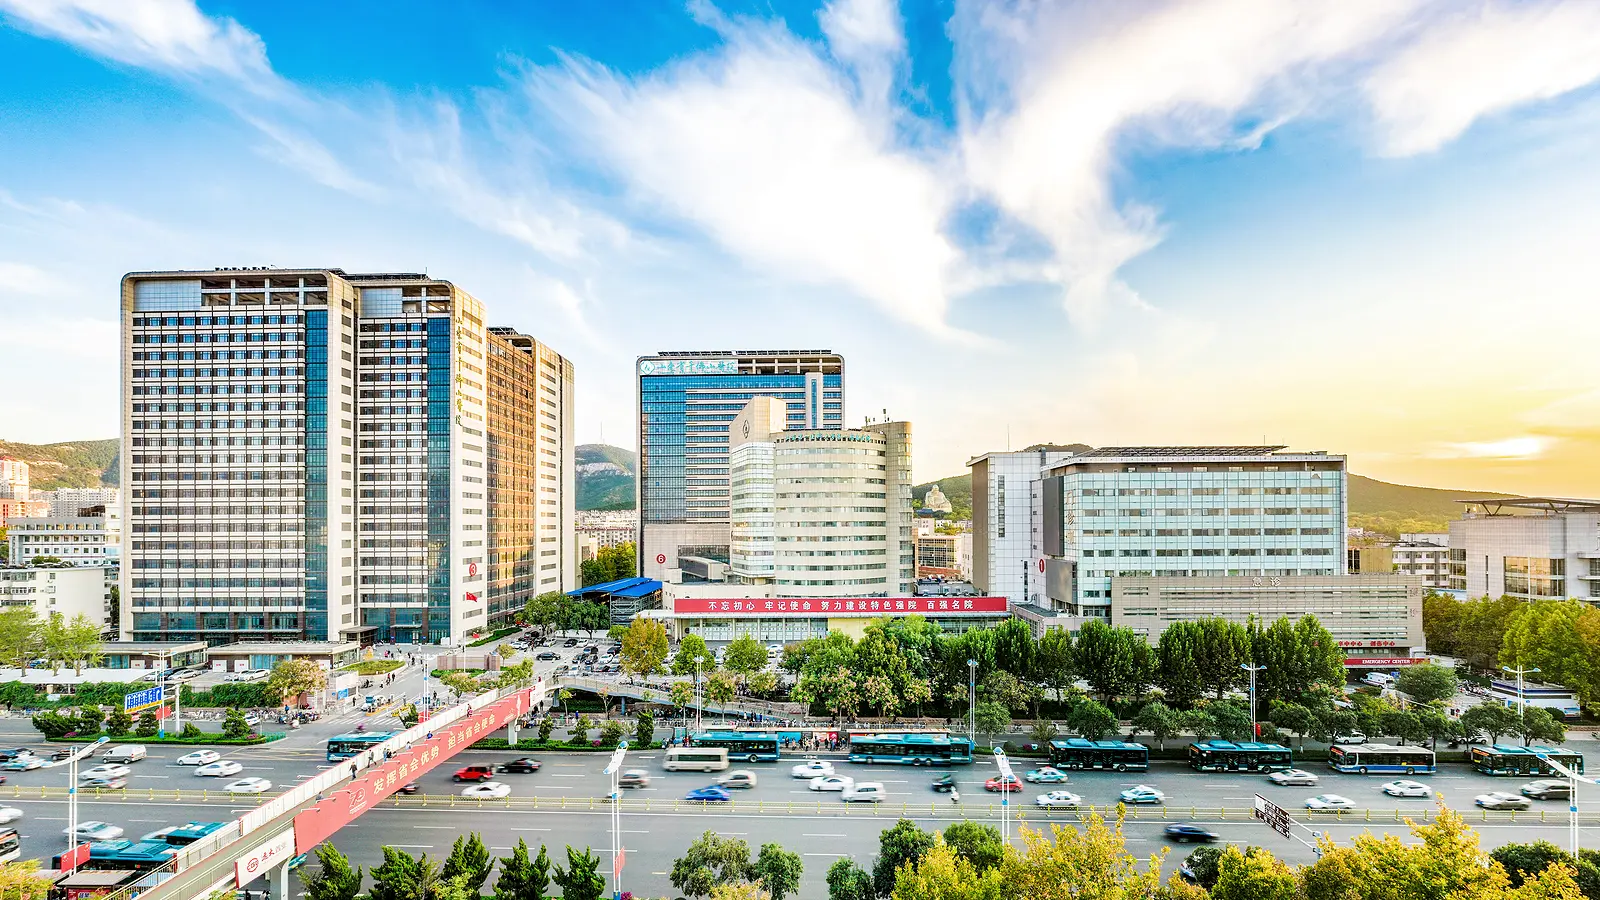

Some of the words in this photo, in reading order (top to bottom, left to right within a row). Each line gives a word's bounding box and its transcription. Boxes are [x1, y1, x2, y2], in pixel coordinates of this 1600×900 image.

[1252, 577, 1281, 587] 急诊
[708, 601, 755, 610] 不忘初心
[765, 601, 811, 610] 牢记使命
[821, 601, 918, 610] 努力建设特色强院
[927, 600, 974, 610] 百强名院
[373, 745, 440, 795] 发挥省会优势
[447, 714, 495, 750] 担当省会使命
